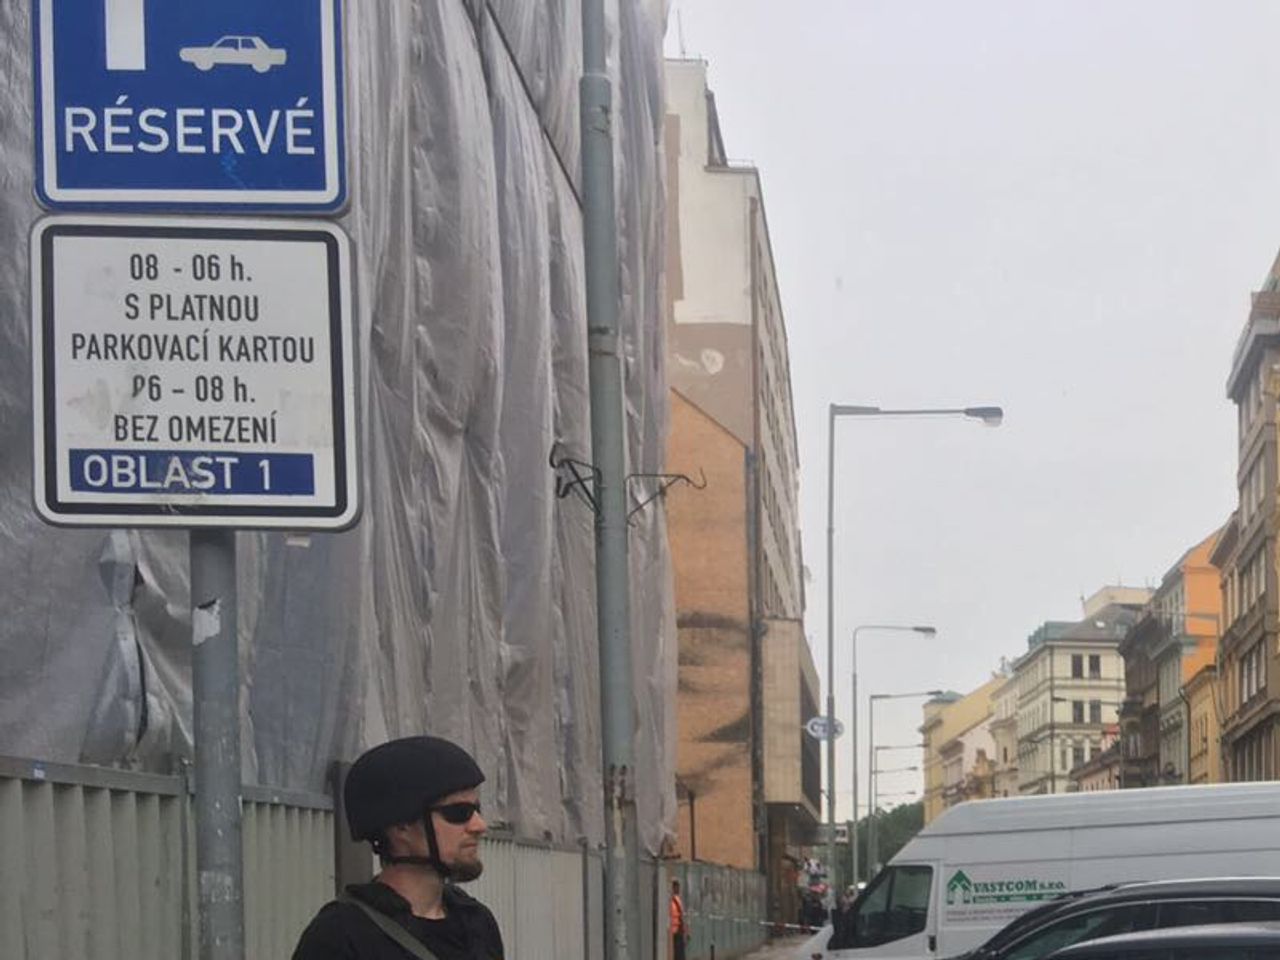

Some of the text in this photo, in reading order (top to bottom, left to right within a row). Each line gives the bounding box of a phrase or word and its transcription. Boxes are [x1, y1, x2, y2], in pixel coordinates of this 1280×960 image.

[65, 95, 315, 155] RÉSERVÉ
[130, 253, 159, 281] 08
[192, 254, 221, 281] 06
[230, 254, 252, 282] h.
[124, 292, 259, 322] S PLATNOU
[71, 328, 314, 364] PARKOVACÍ KARTOU
[195, 374, 224, 402] 08
[233, 375, 256, 403] h.
[113, 410, 277, 444] BEZ OMEZENÍ
[83, 455, 271, 491] OBLAST 1
